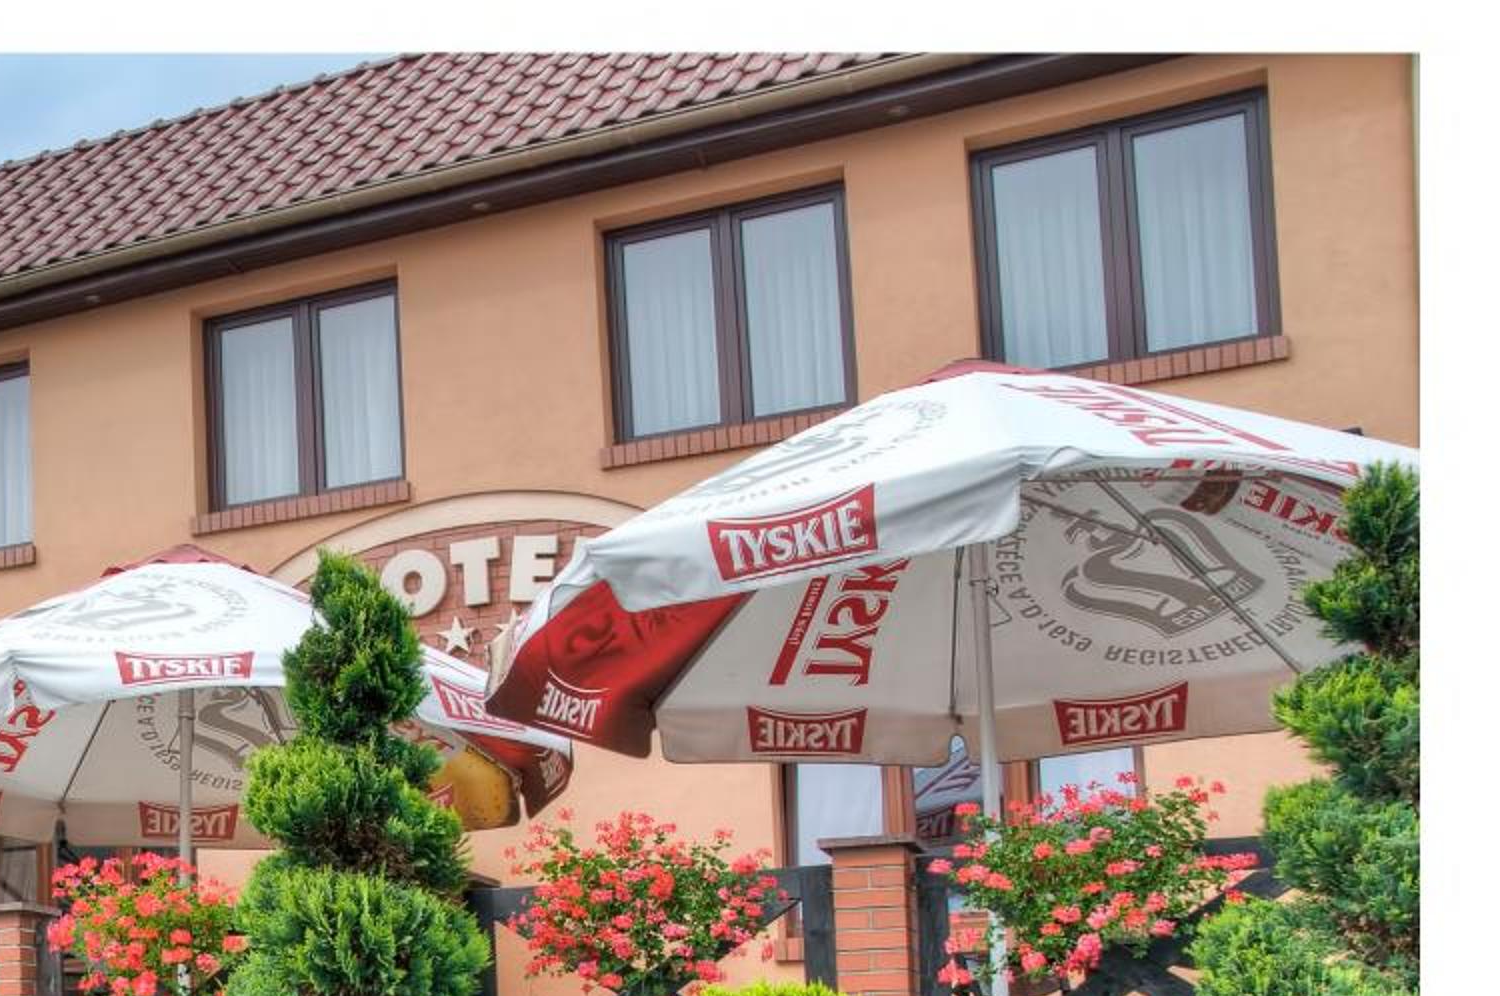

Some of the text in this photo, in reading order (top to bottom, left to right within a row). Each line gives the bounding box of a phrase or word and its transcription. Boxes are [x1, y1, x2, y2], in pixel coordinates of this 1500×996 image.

[718, 498, 869, 574] TYSKIE
[380, 534, 592, 618] OTE
[125, 656, 245, 680] TYSKIE
[439, 683, 488, 721] TYS
